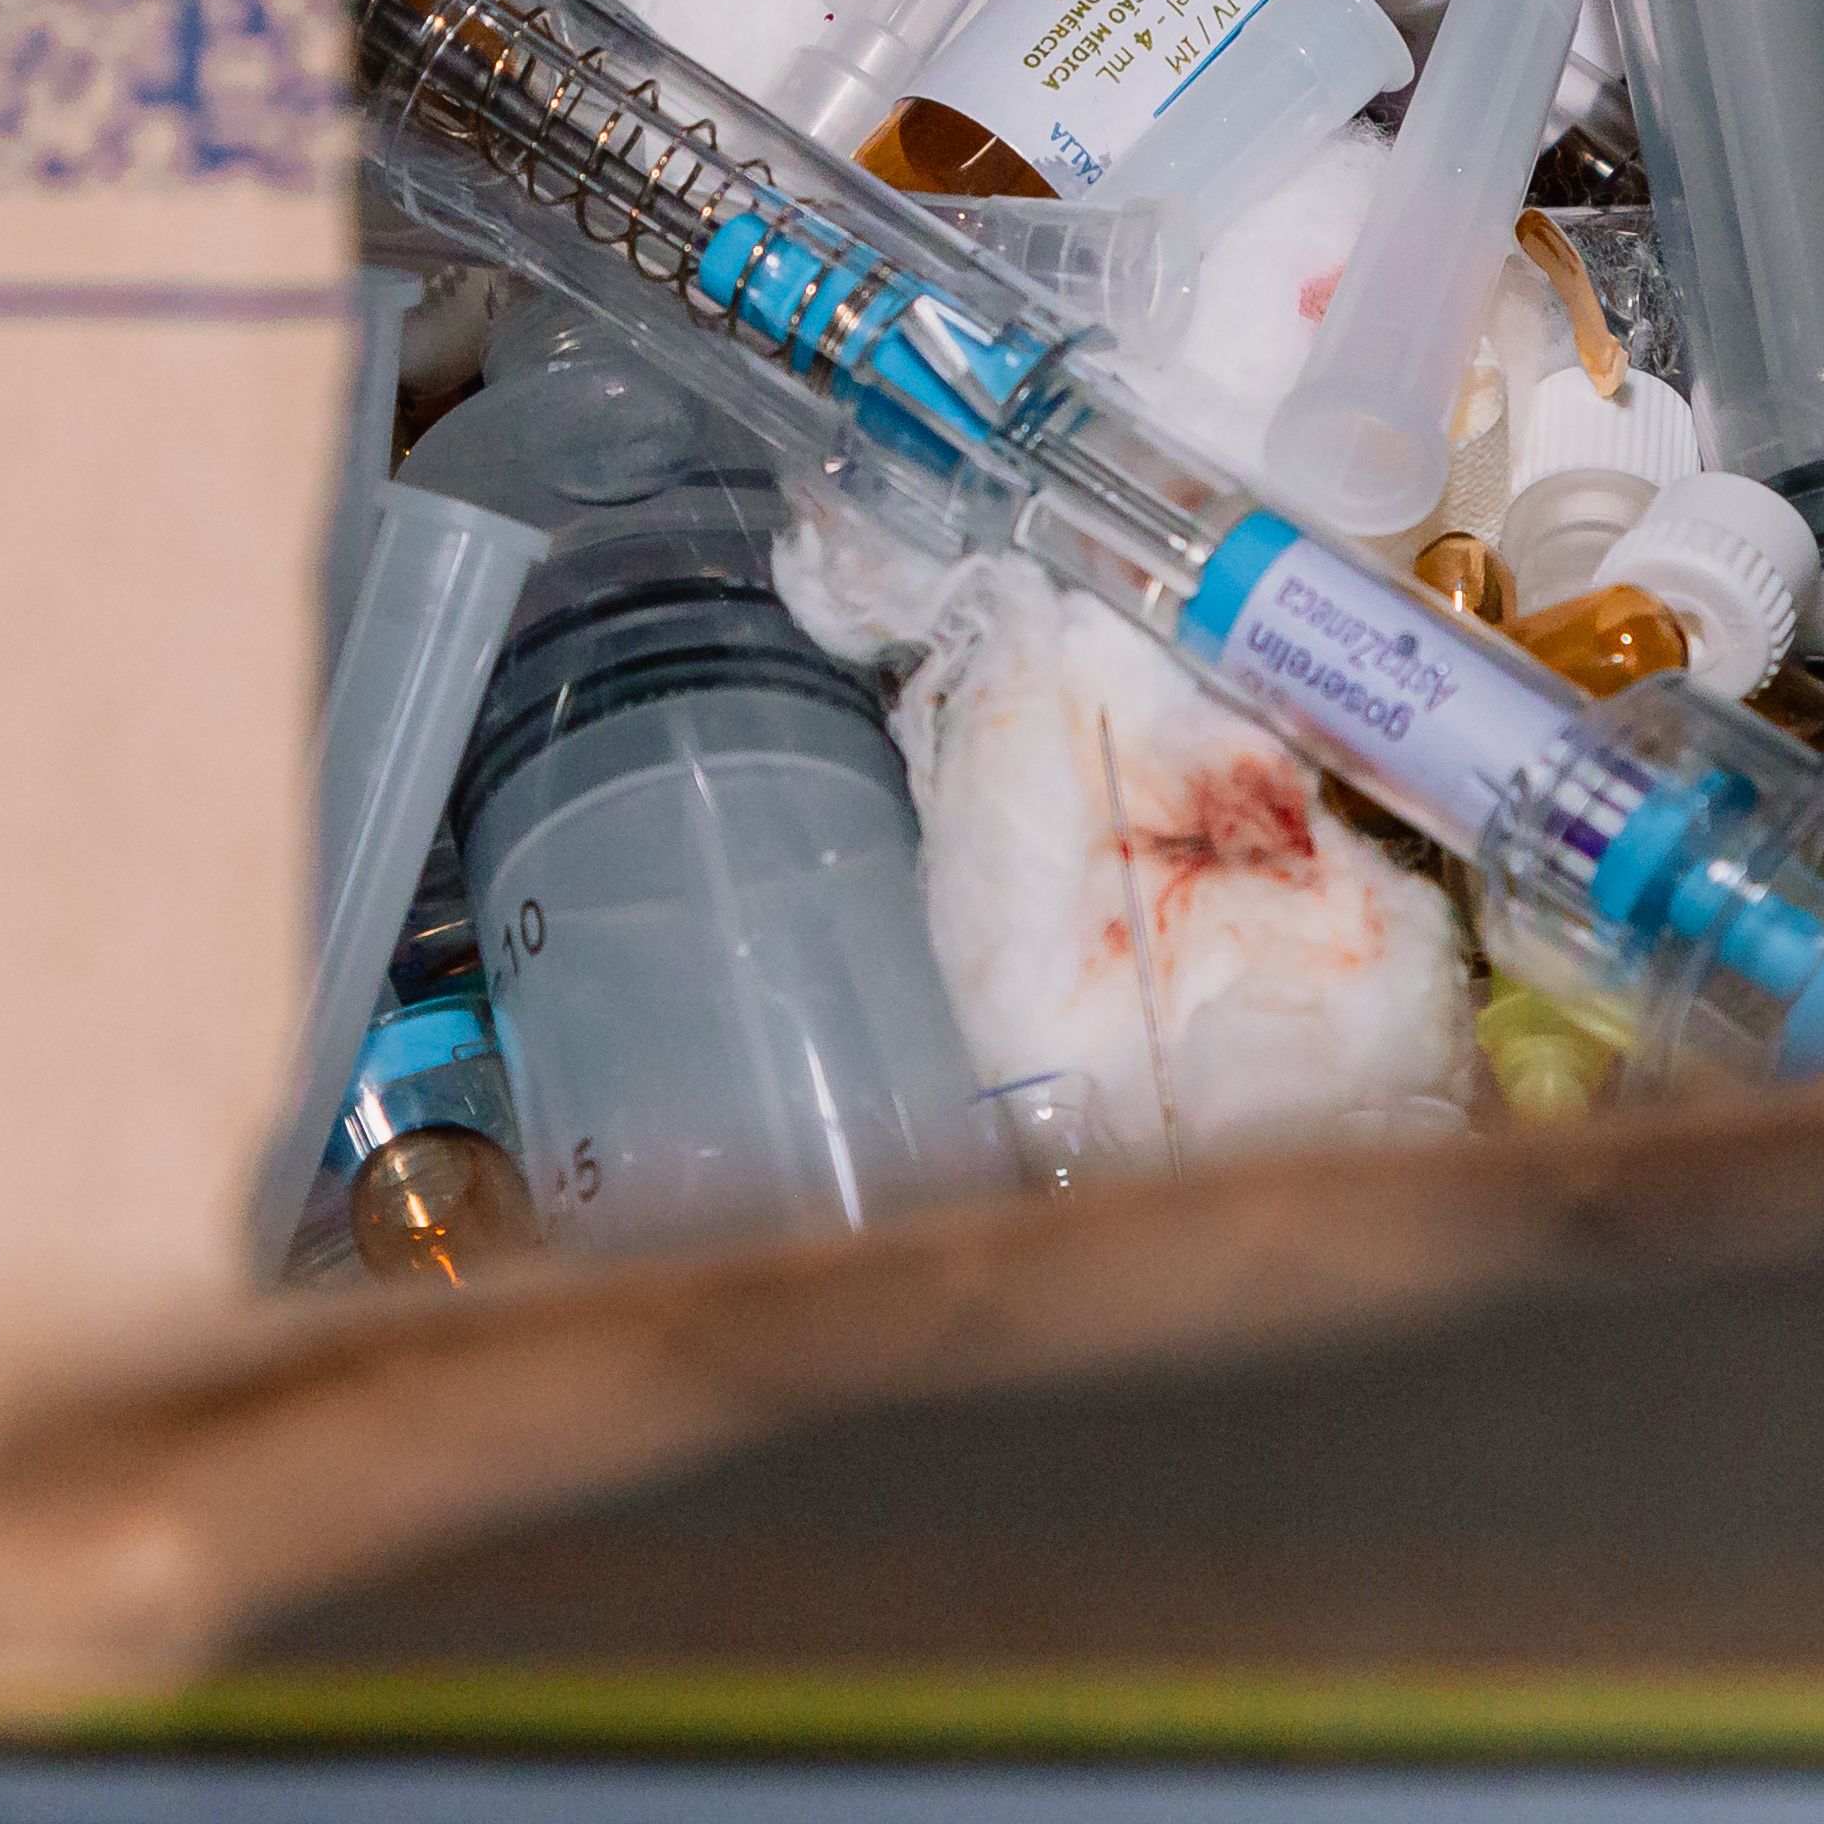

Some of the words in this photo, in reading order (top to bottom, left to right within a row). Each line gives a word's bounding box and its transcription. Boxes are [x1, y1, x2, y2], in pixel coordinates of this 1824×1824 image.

[1039, 21, 1113, 91] MÉDICA
[1132, 27, 1153, 52] 4
[1163, 34, 1201, 76] IM
[1195, 14, 1211, 45] /
[1094, 45, 1135, 84] mL
[1276, 577, 1457, 711] AstraZeneca
[1247, 622, 1415, 742] goserelin
[502, 898, 545, 977] 10
